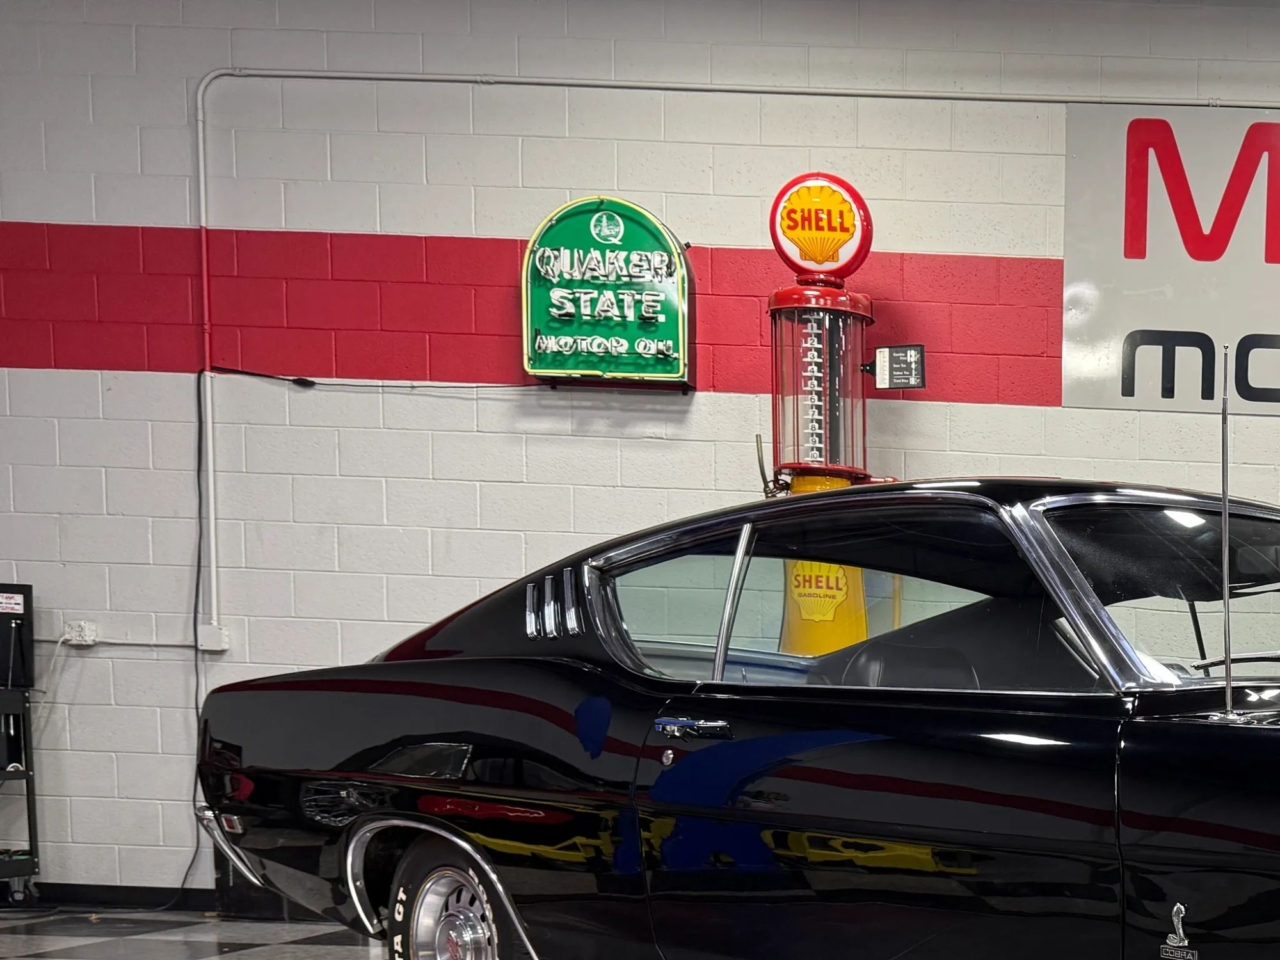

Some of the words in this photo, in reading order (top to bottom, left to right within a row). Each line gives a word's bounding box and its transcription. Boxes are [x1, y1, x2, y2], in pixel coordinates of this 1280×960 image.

[786, 208, 850, 233] SHELL
[535, 247, 676, 283] QUAKER
[549, 288, 666, 322] STATE
[535, 335, 629, 356] MOTOR
[634, 337, 680, 359] OIL
[793, 574, 843, 591] SHELL
[797, 592, 837, 600] GASOLINE
[394, 886, 407, 922] GT
[1162, 947, 1194, 960] COBRA
